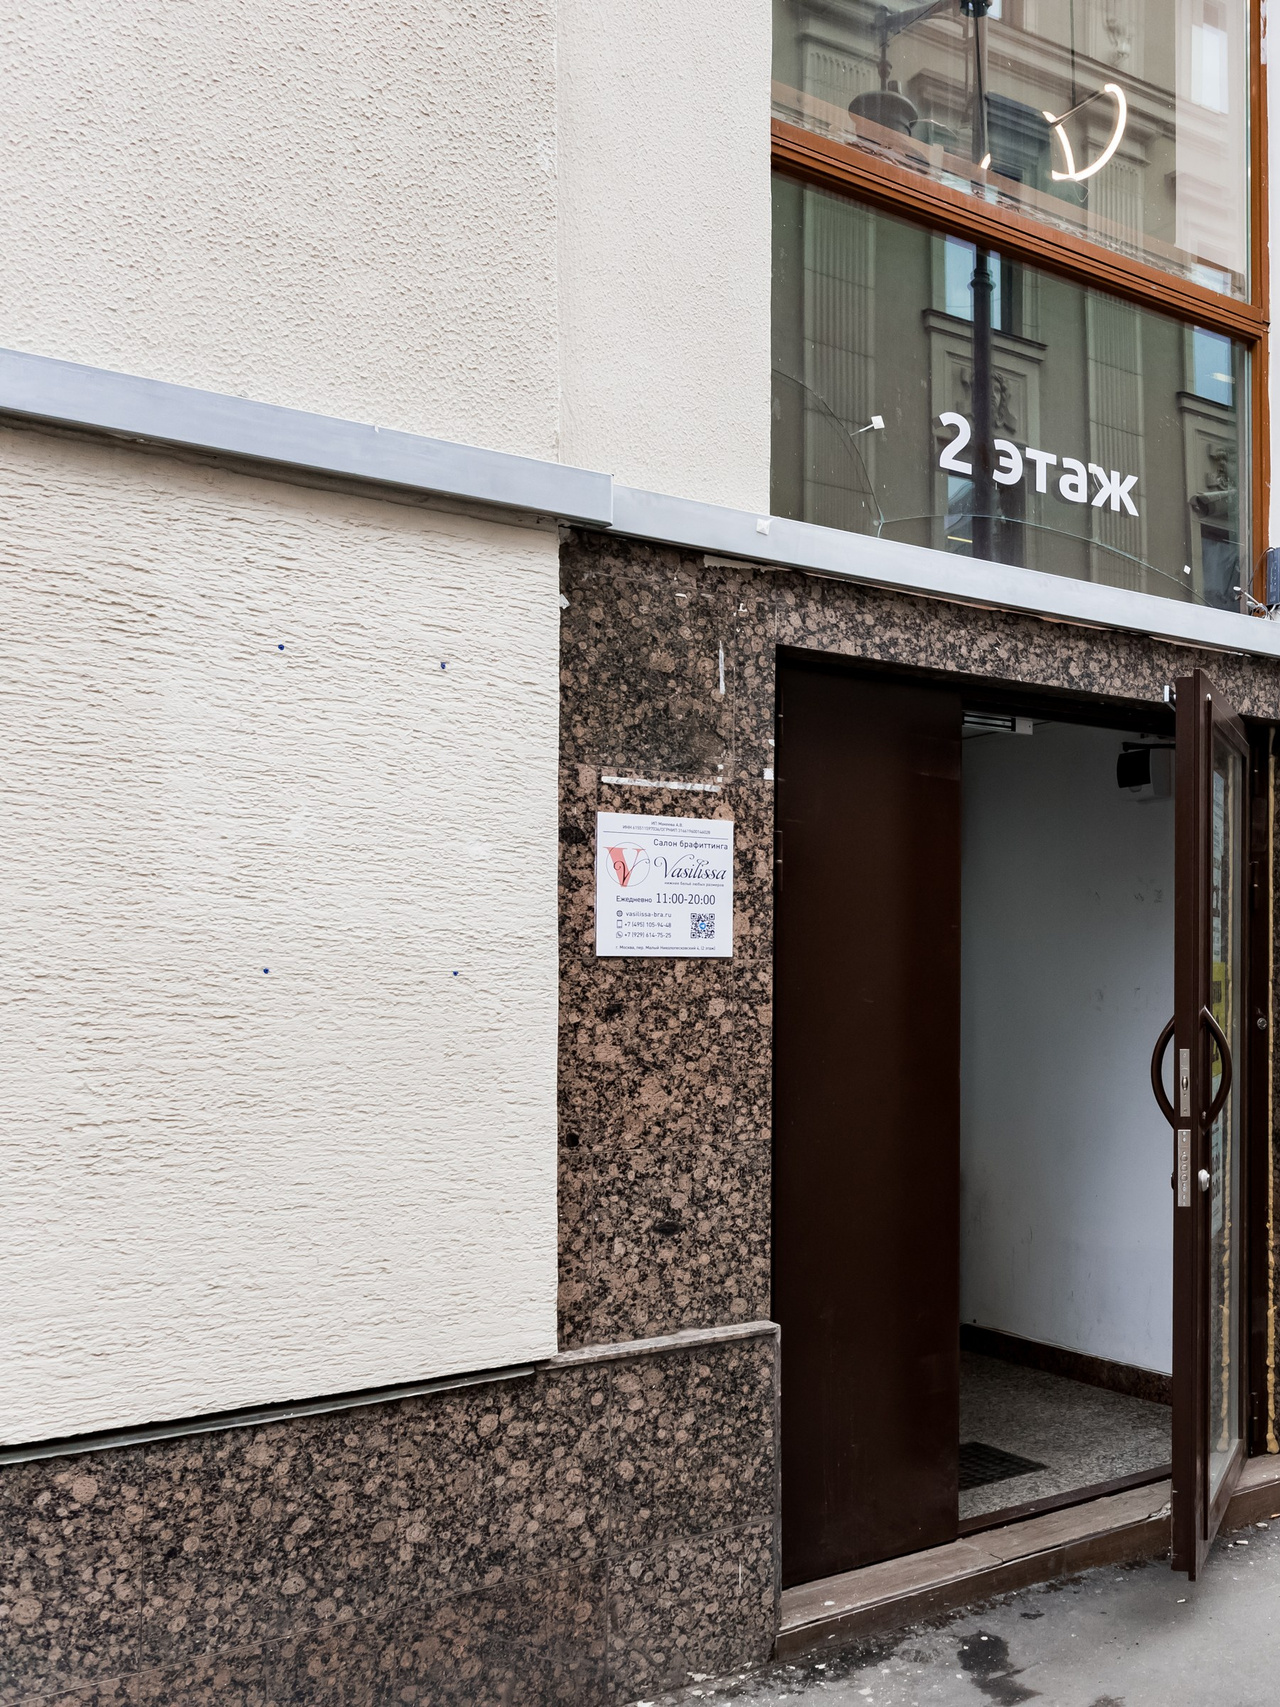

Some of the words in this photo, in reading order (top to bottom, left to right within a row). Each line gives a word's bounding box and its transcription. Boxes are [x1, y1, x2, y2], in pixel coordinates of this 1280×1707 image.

[938, 411, 974, 475] 2
[991, 438, 1139, 517] этаж
[653, 838, 678, 847] Салон
[679, 840, 729, 850] брафиттинга
[653, 854, 727, 880] Vasilissa
[616, 895, 652, 903] Ежедневно
[656, 893, 716, 905] 11:00-20:00
